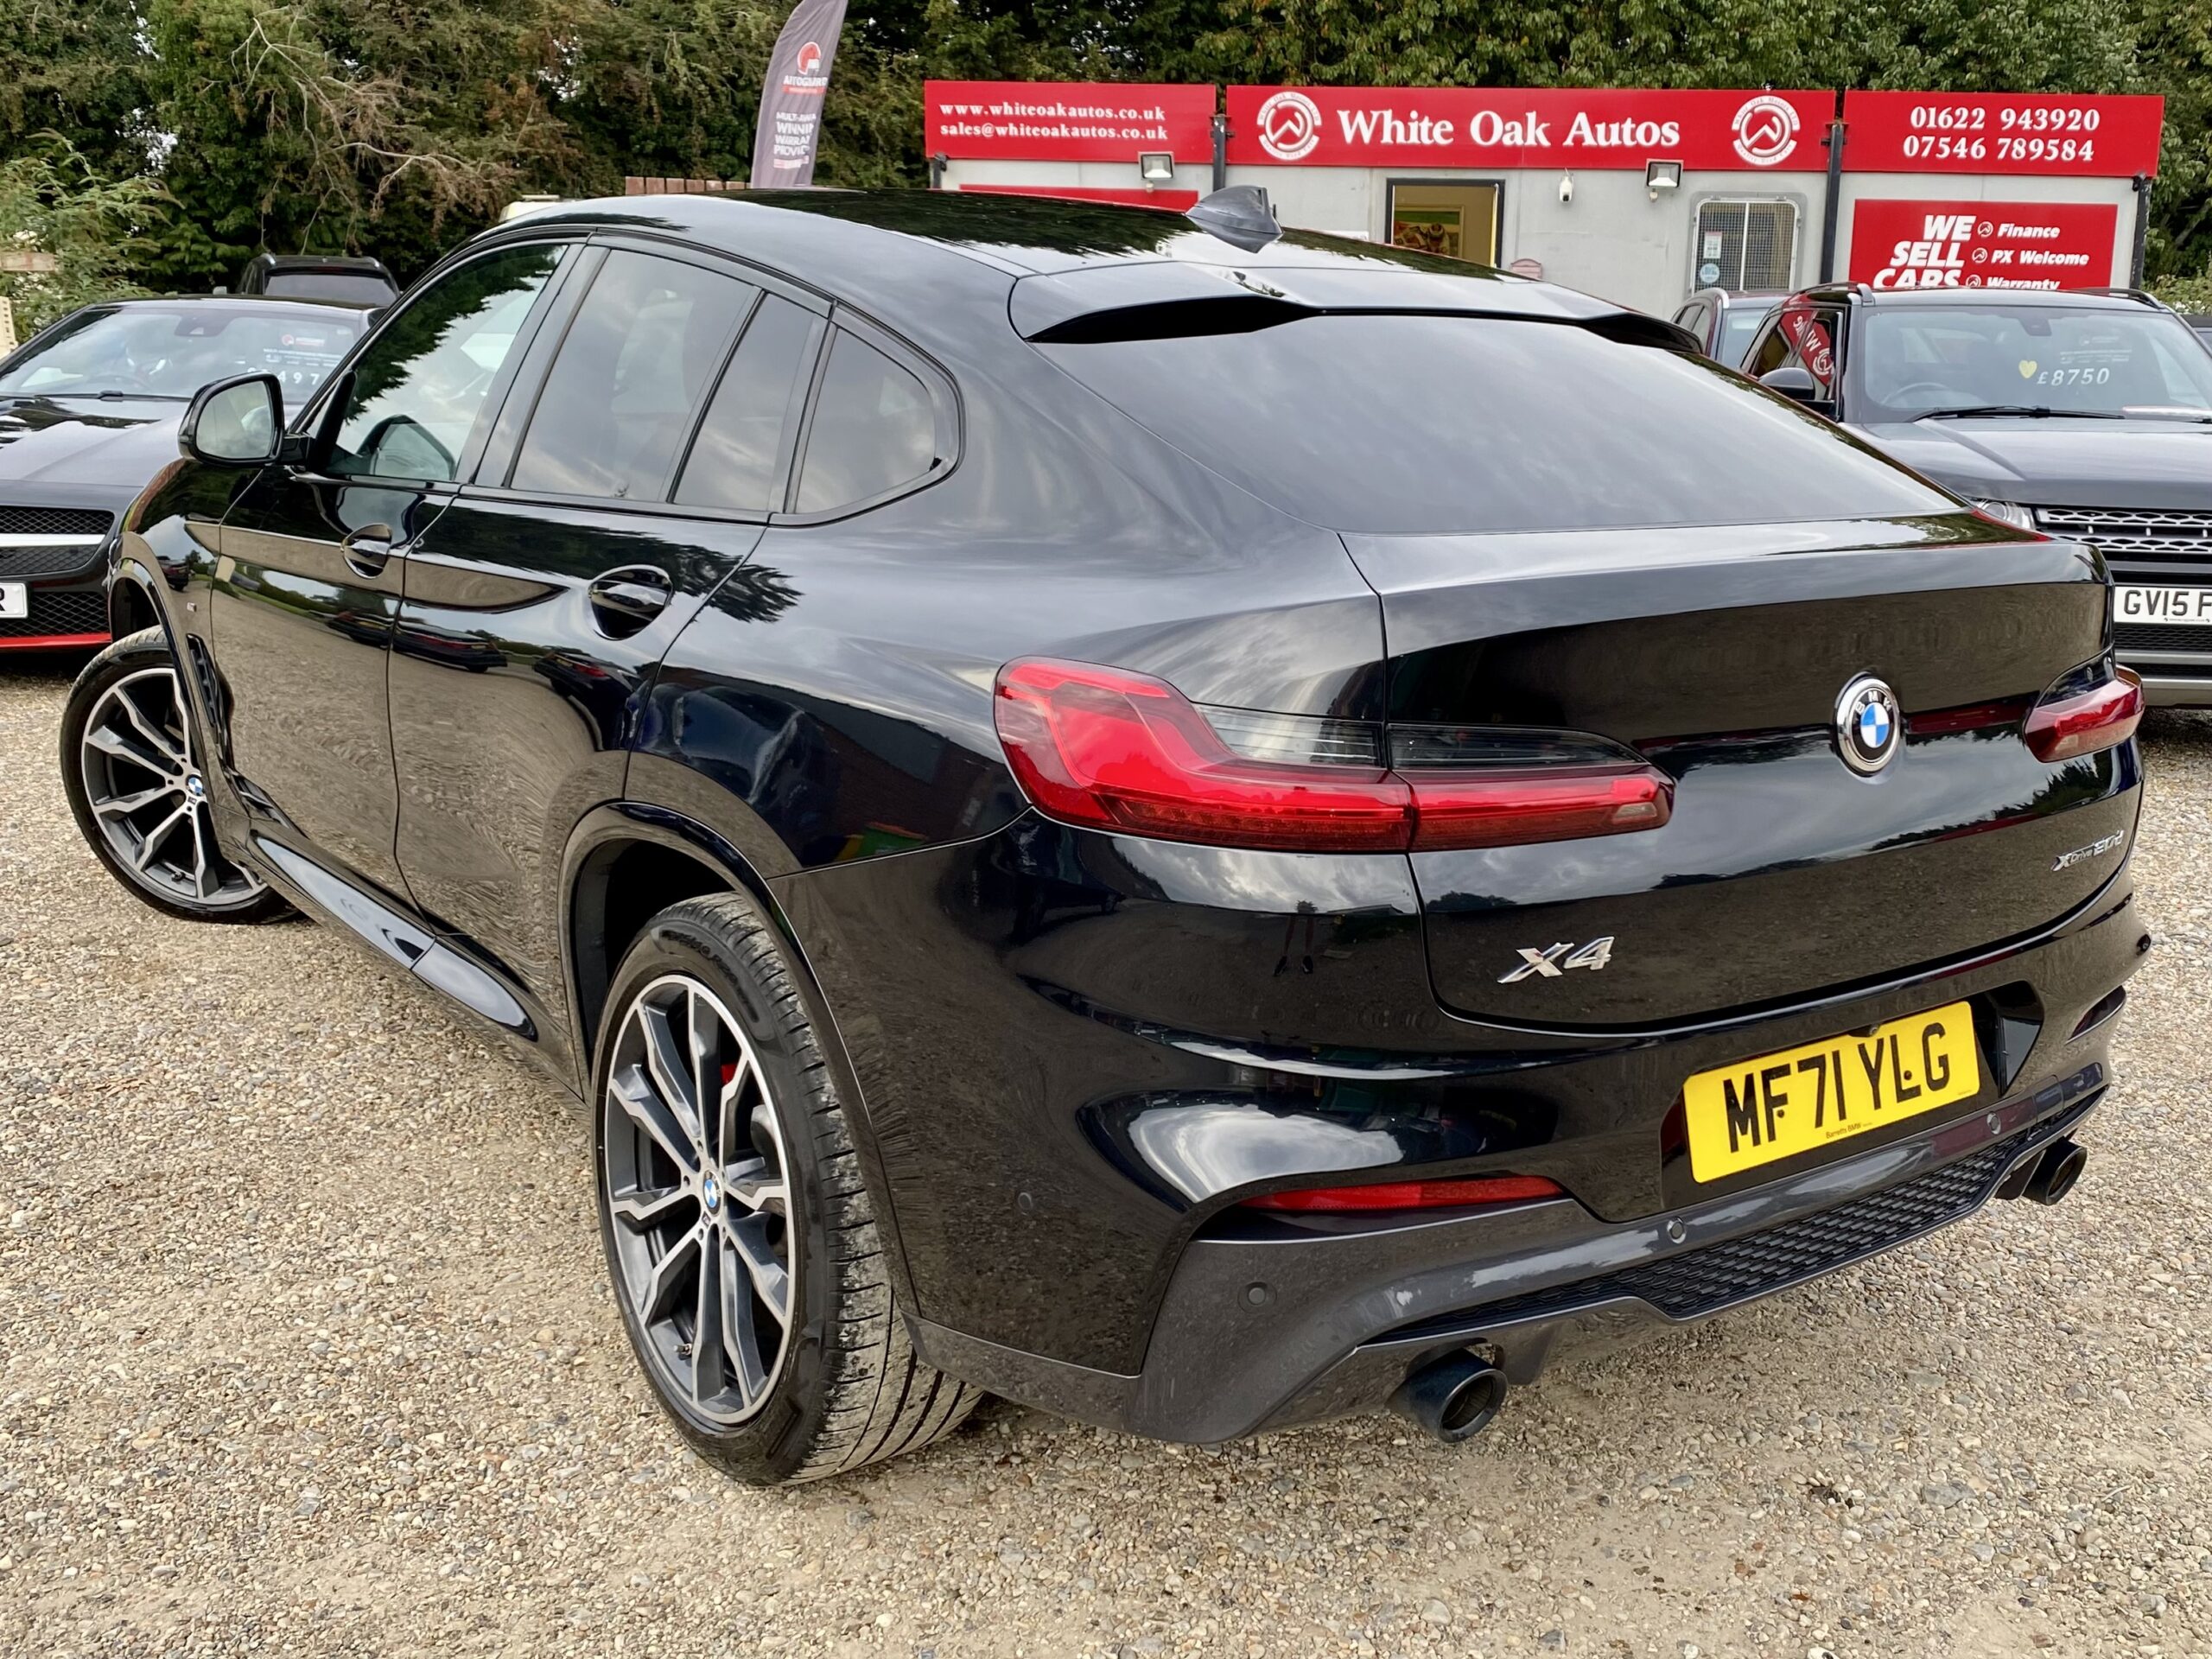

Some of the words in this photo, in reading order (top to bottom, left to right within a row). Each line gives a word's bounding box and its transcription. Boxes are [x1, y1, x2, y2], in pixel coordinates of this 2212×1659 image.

[939, 102, 1166, 120] www.whiteoakautos.co.uk
[1910, 105, 1986, 130] 01622
[1999, 108, 2101, 131] 943920
[939, 122, 1168, 139] sales@whiteoakautos.co.uk
[1336, 109, 1455, 146] White
[1470, 111, 1552, 148] Oak
[1562, 112, 1681, 148] Autos
[1903, 135, 1987, 158] 07546
[1997, 137, 2094, 162] 789584
[1923, 214, 1977, 240] WE
[1997, 223, 2061, 238] Finance
[1890, 241, 1965, 267] SELL
[1991, 250, 2015, 264] PX
[2019, 250, 2090, 265] Welcome
[1873, 268, 1962, 289] CARS
[1986, 276, 2061, 290] Warranty
[2037, 368, 2110, 386] £8750
[2123, 589, 2190, 616] GV15
[1855, 690, 1892, 715] BMW
[1497, 936, 1615, 984] X4
[1723, 1049, 1847, 1154] MF71
[1857, 1021, 1950, 1112] YLG
